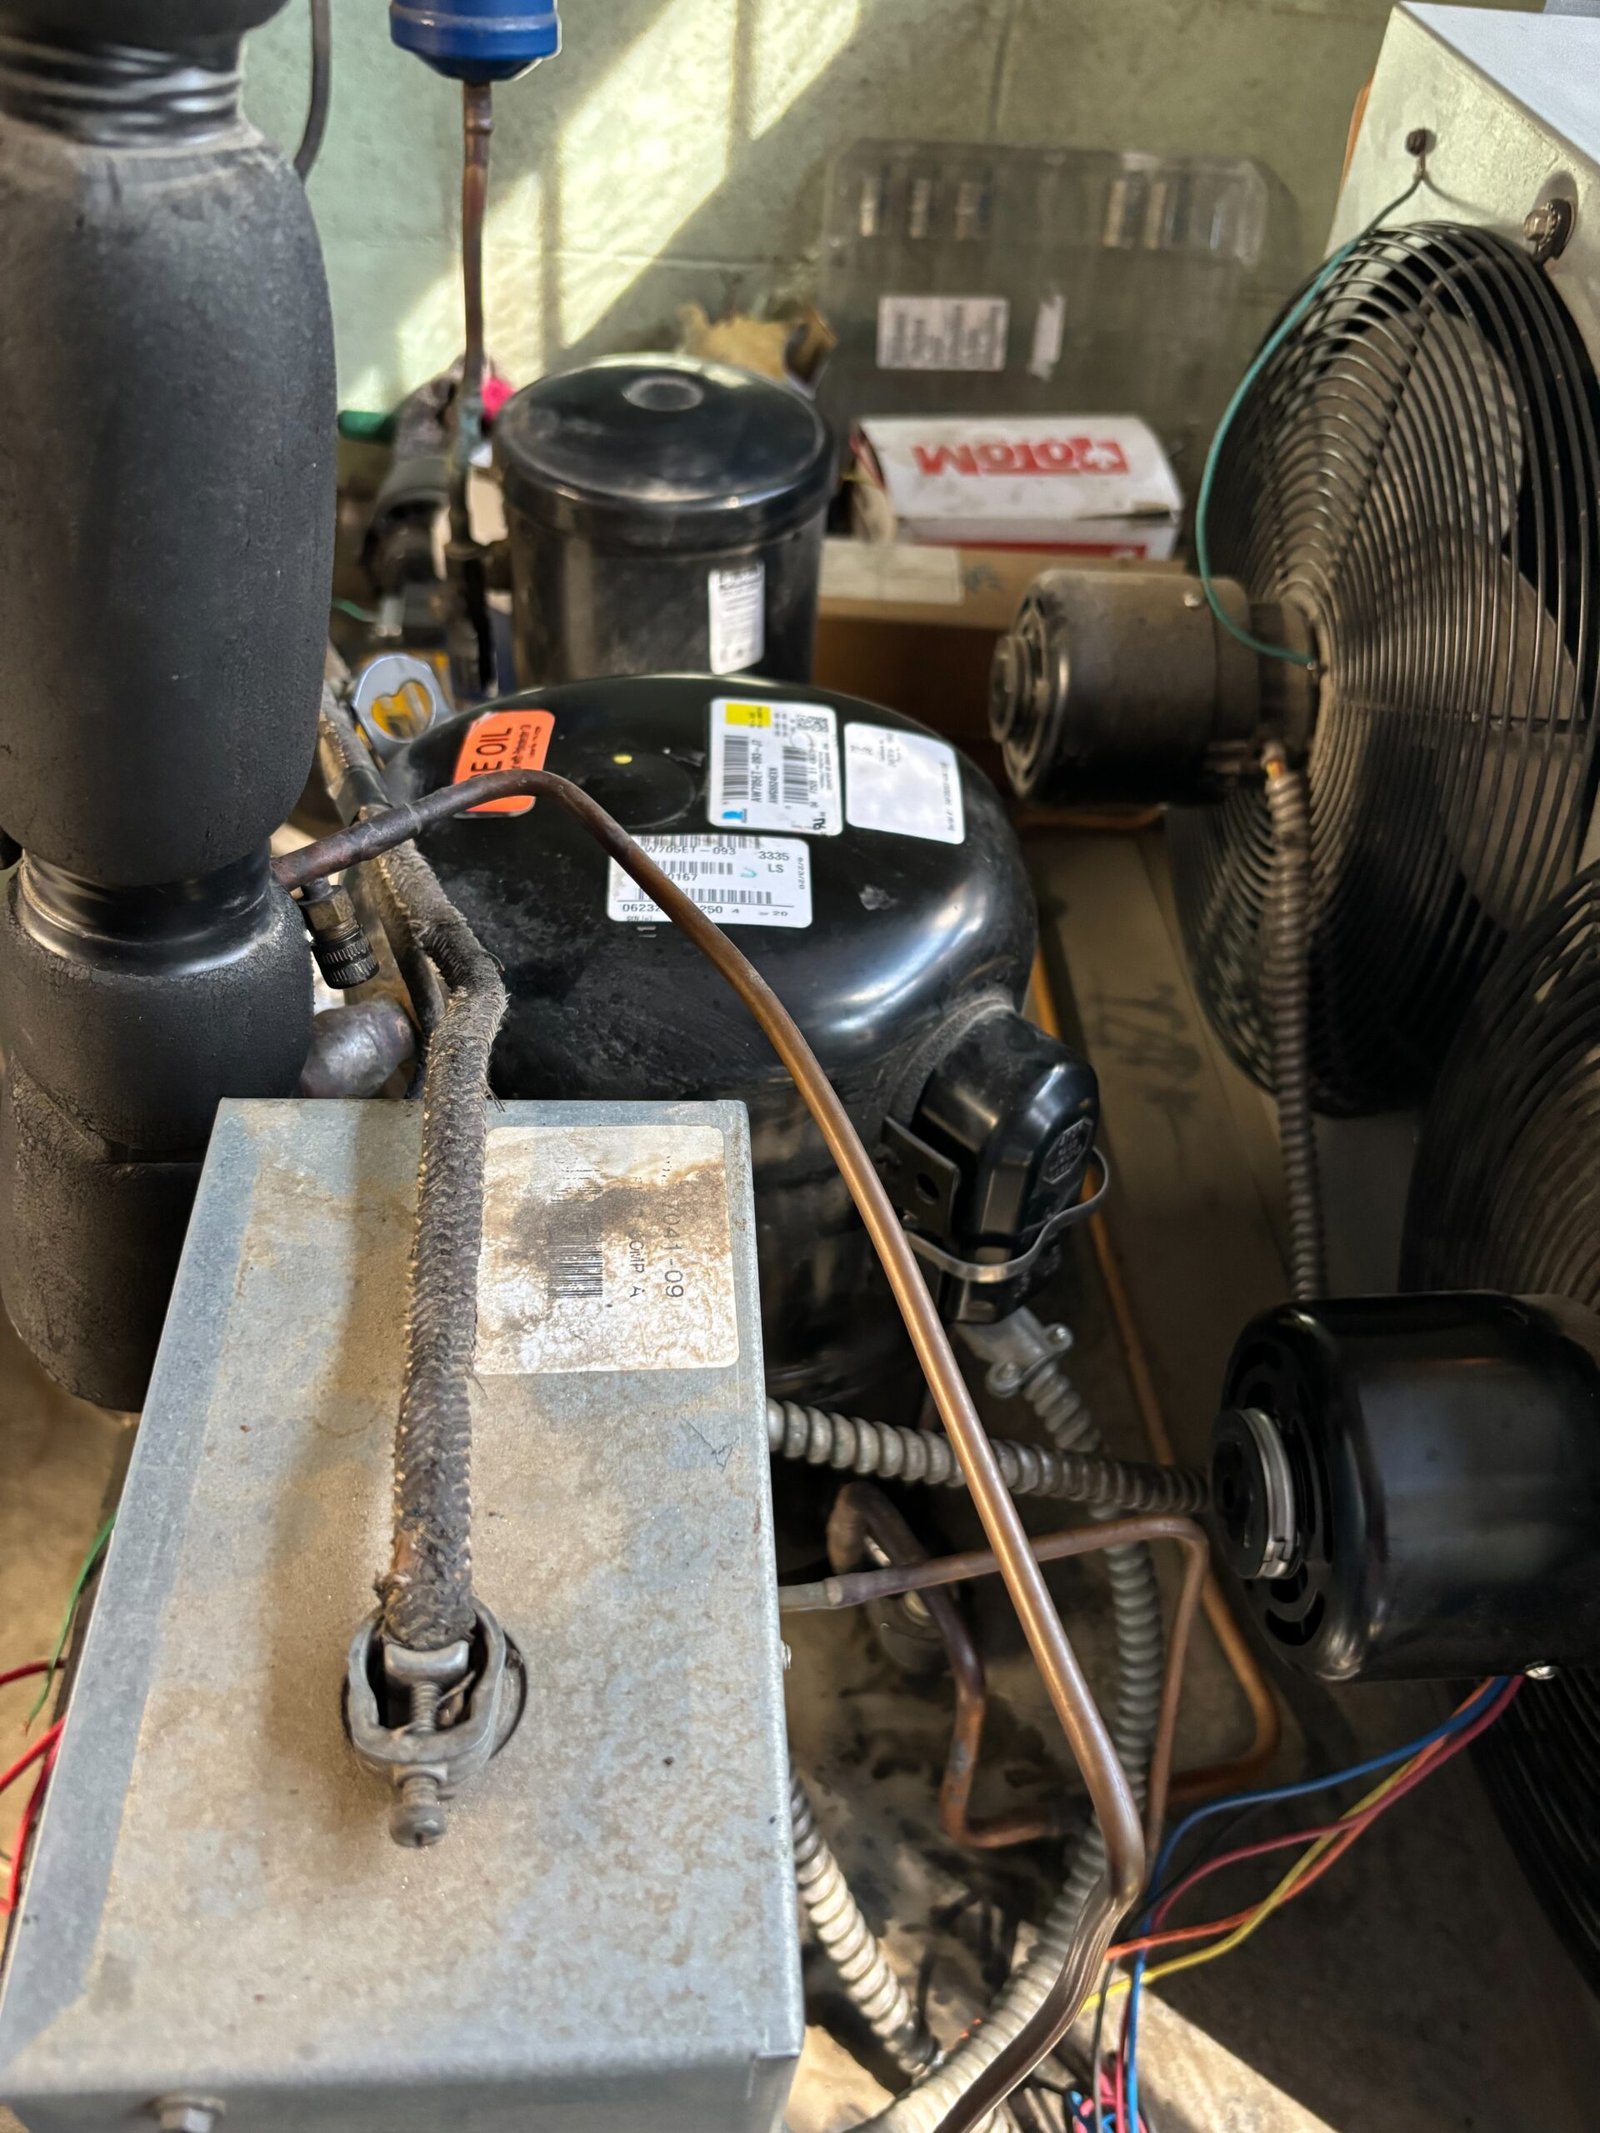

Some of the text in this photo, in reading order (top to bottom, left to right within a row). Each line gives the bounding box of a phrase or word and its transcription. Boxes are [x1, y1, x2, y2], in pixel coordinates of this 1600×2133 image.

[476, 728, 513, 756] OIL
[758, 850, 790, 861] 3335
[768, 863, 784, 873] LS
